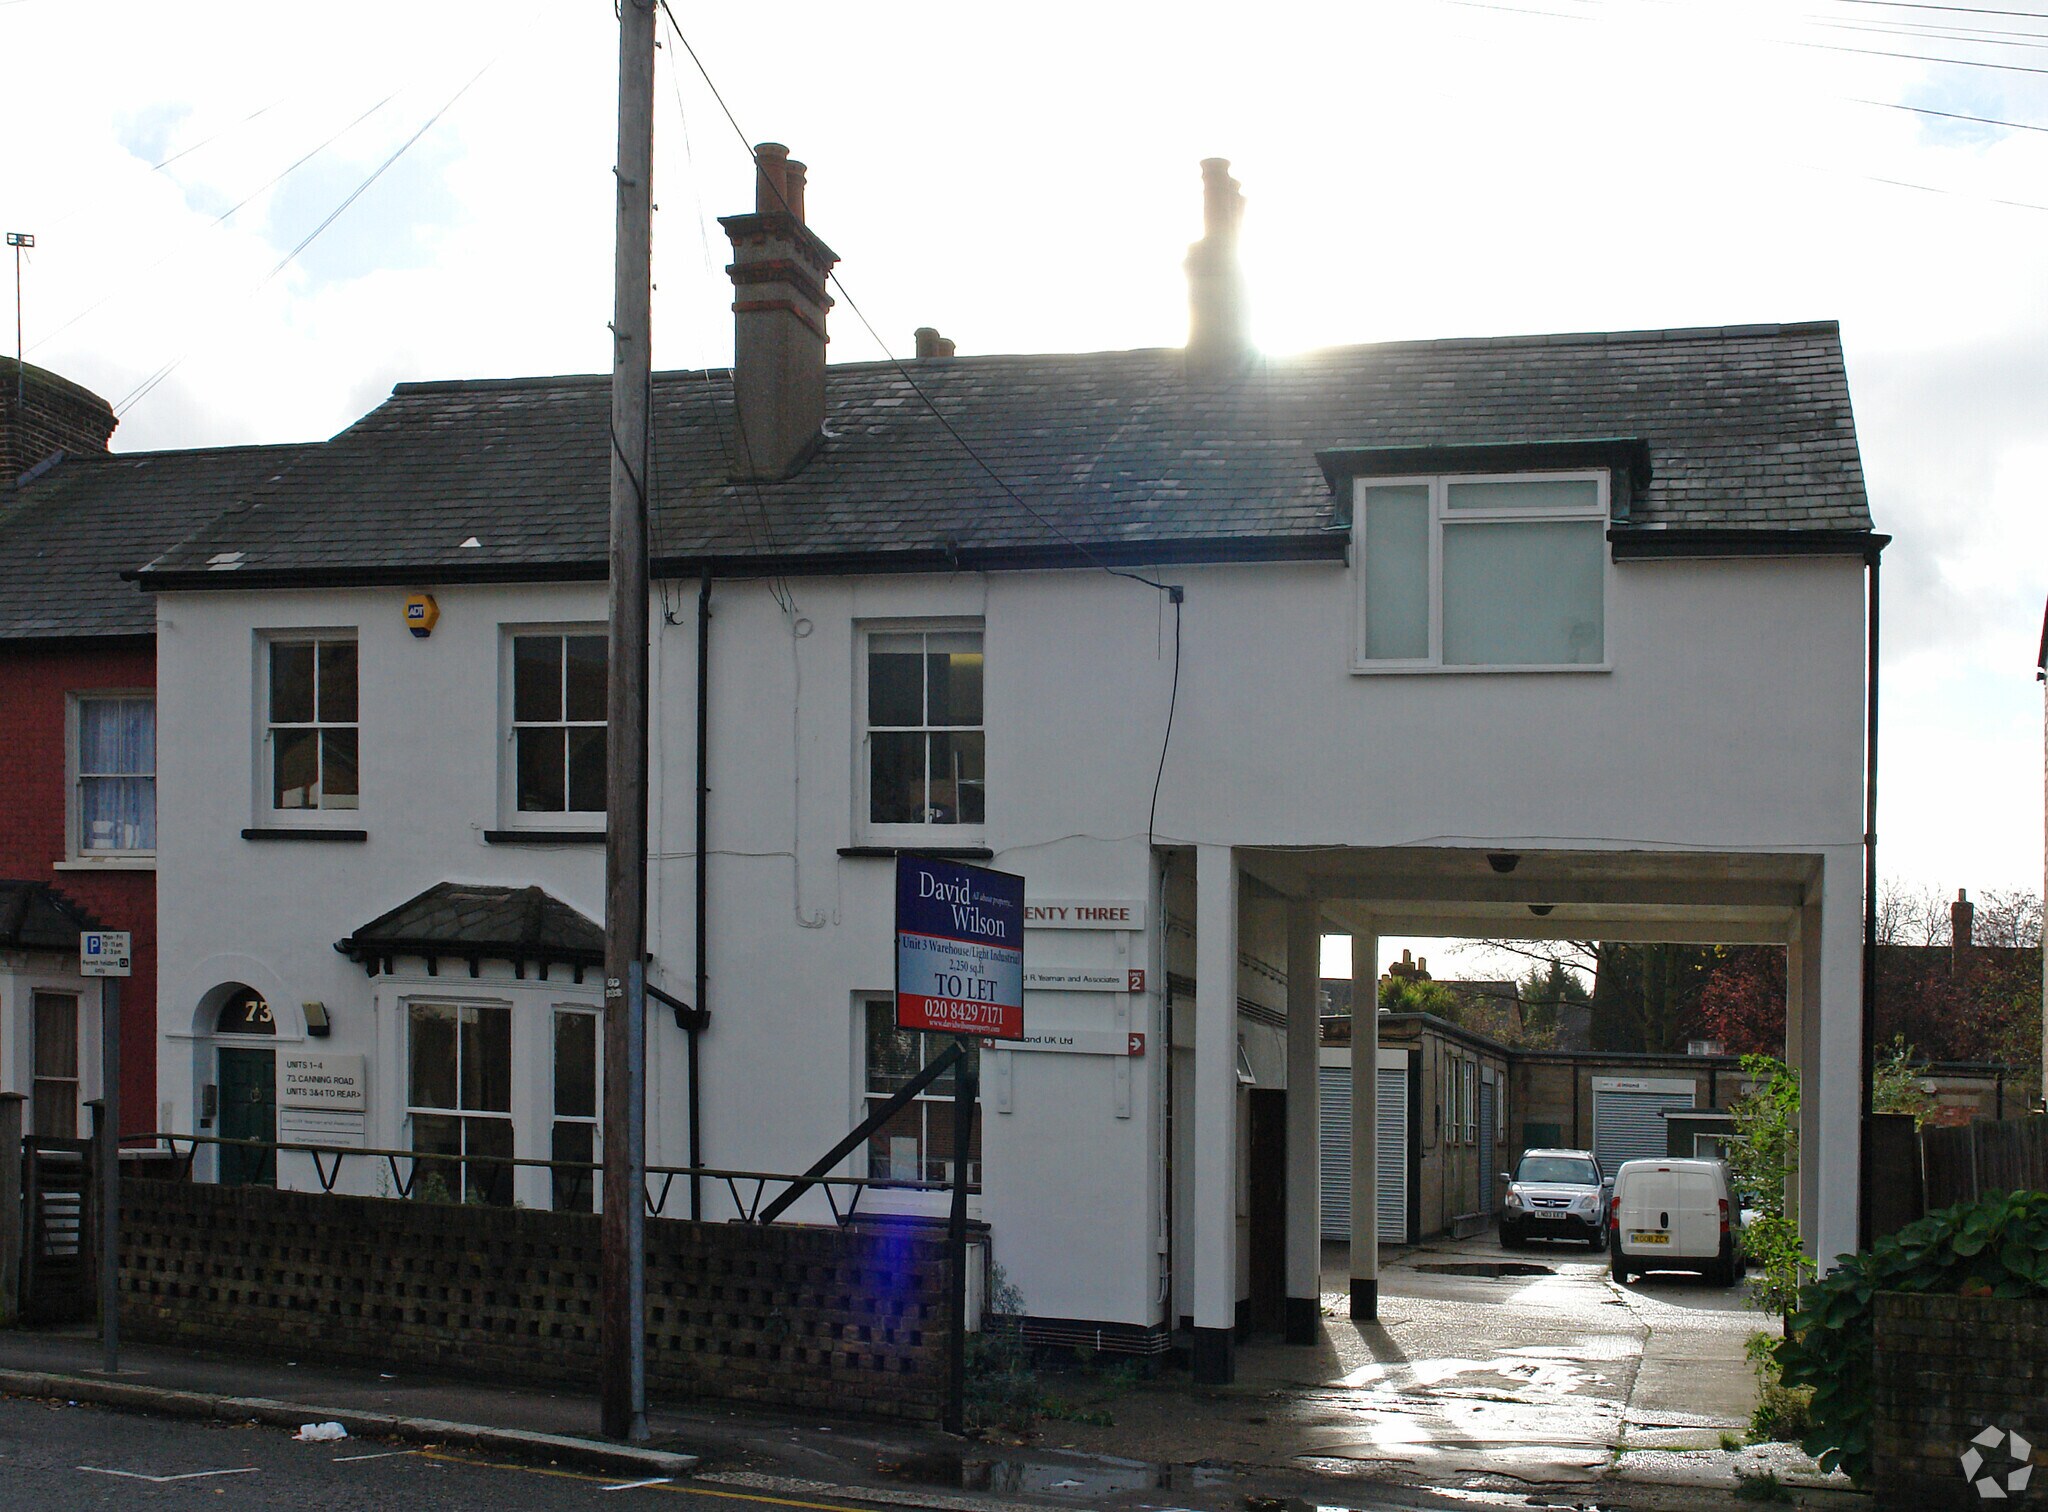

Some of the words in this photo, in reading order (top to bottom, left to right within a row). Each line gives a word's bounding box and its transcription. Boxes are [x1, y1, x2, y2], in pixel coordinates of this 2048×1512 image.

[408, 606, 424, 616] ADT
[918, 871, 971, 905] David
[951, 904, 1006, 938] Wilson
[1075, 907, 1131, 921] THREE
[902, 936, 921, 951] Unit
[922, 939, 928, 951] 3
[929, 940, 989, 962] Warehouse/Light
[990, 949, 1020, 966] Industrial
[949, 958, 969, 974] 2,250
[1038, 975, 1065, 983] Yeaman
[1067, 975, 1082, 983] and
[1083, 975, 1120, 984] Associates
[1131, 976, 1141, 990] 2
[934, 972, 962, 998] TO
[967, 977, 998, 1002] LET
[245, 1000, 273, 1022] 73
[924, 998, 948, 1019] 020
[950, 1001, 978, 1021] 8429
[980, 1005, 1003, 1025] 7171
[1044, 1036, 1057, 1044] UK
[1059, 1037, 1073, 1045] Ltd
[286, 1061, 307, 1069] UNITS
[309, 1062, 323, 1070] 1-4
[298, 1075, 332, 1084] CANNING
[333, 1076, 355, 1086] ROAD
[286, 1087, 307, 1097] UNITS
[309, 1088, 324, 1097] 3&4
[325, 1089, 336, 1098] TO
